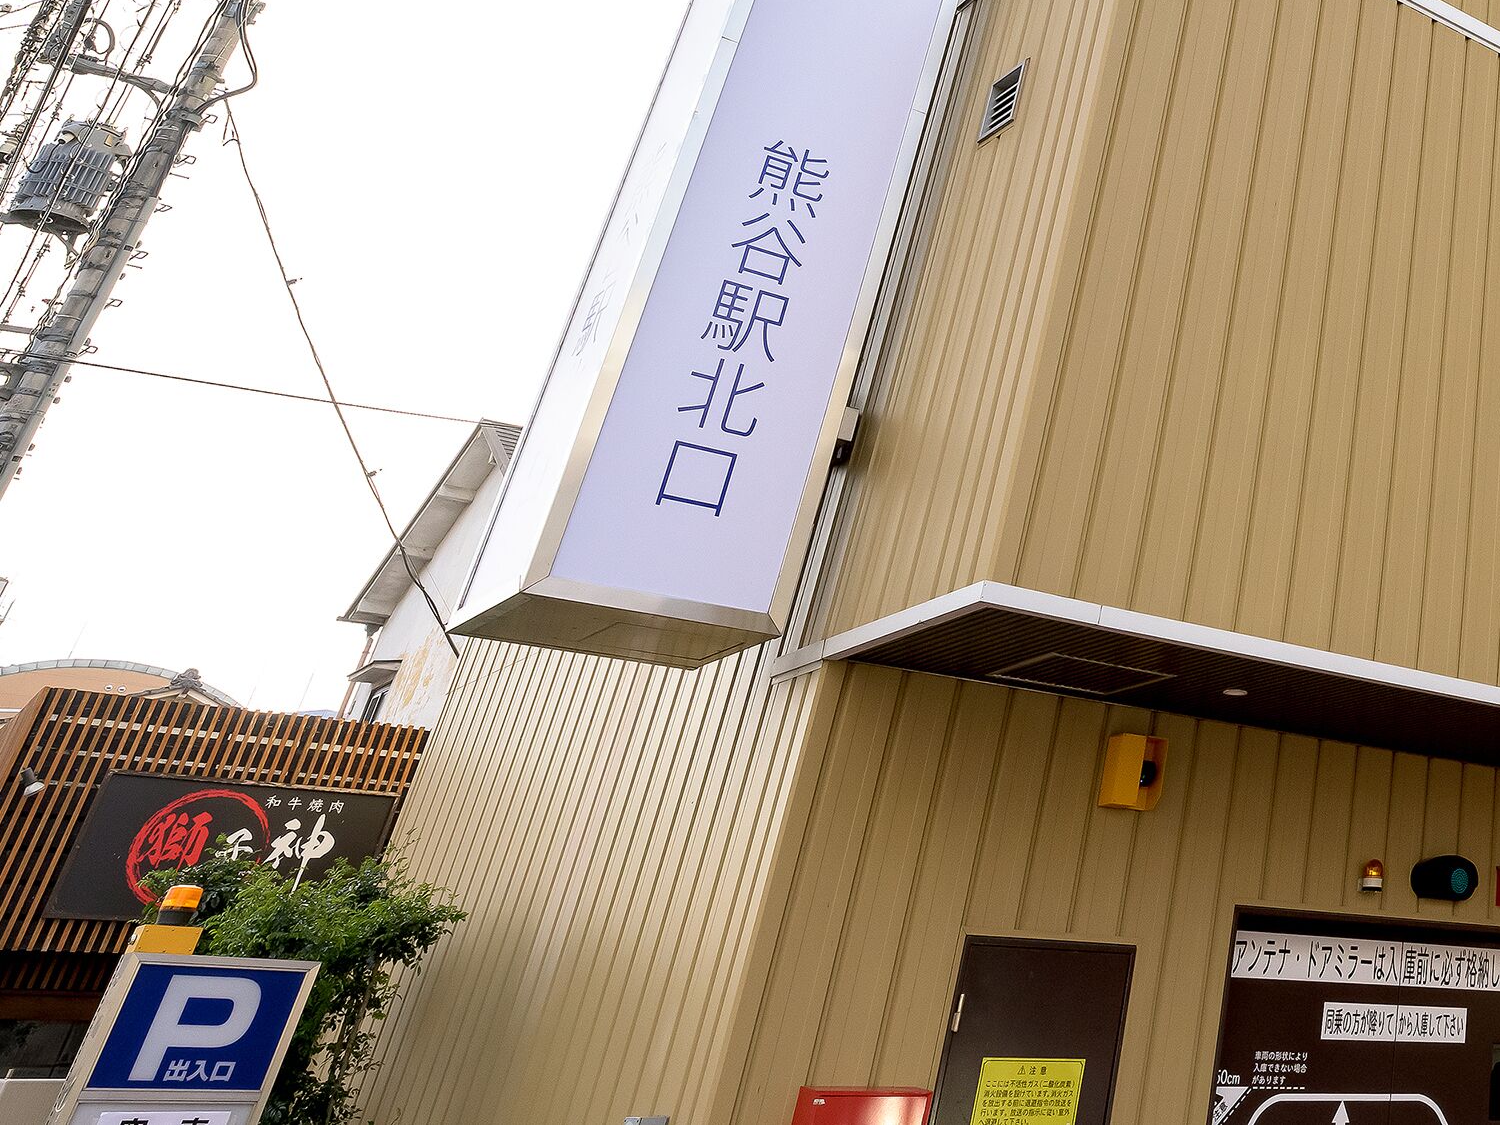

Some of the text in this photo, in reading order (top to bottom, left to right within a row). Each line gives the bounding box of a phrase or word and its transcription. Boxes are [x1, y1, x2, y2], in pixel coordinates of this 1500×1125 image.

[655, 140, 830, 517] 熊谷駅北口
[128, 975, 261, 1081] P
[1324, 1008, 1464, 1038] 同乗の方が降りてから入庫して下さい
[163, 1059, 236, 1082] 出入口
[1029, 1066, 1047, 1075] 注意
[1253, 1062, 1308, 1074] 入庫できない場合
[1251, 1075, 1287, 1085] があります
